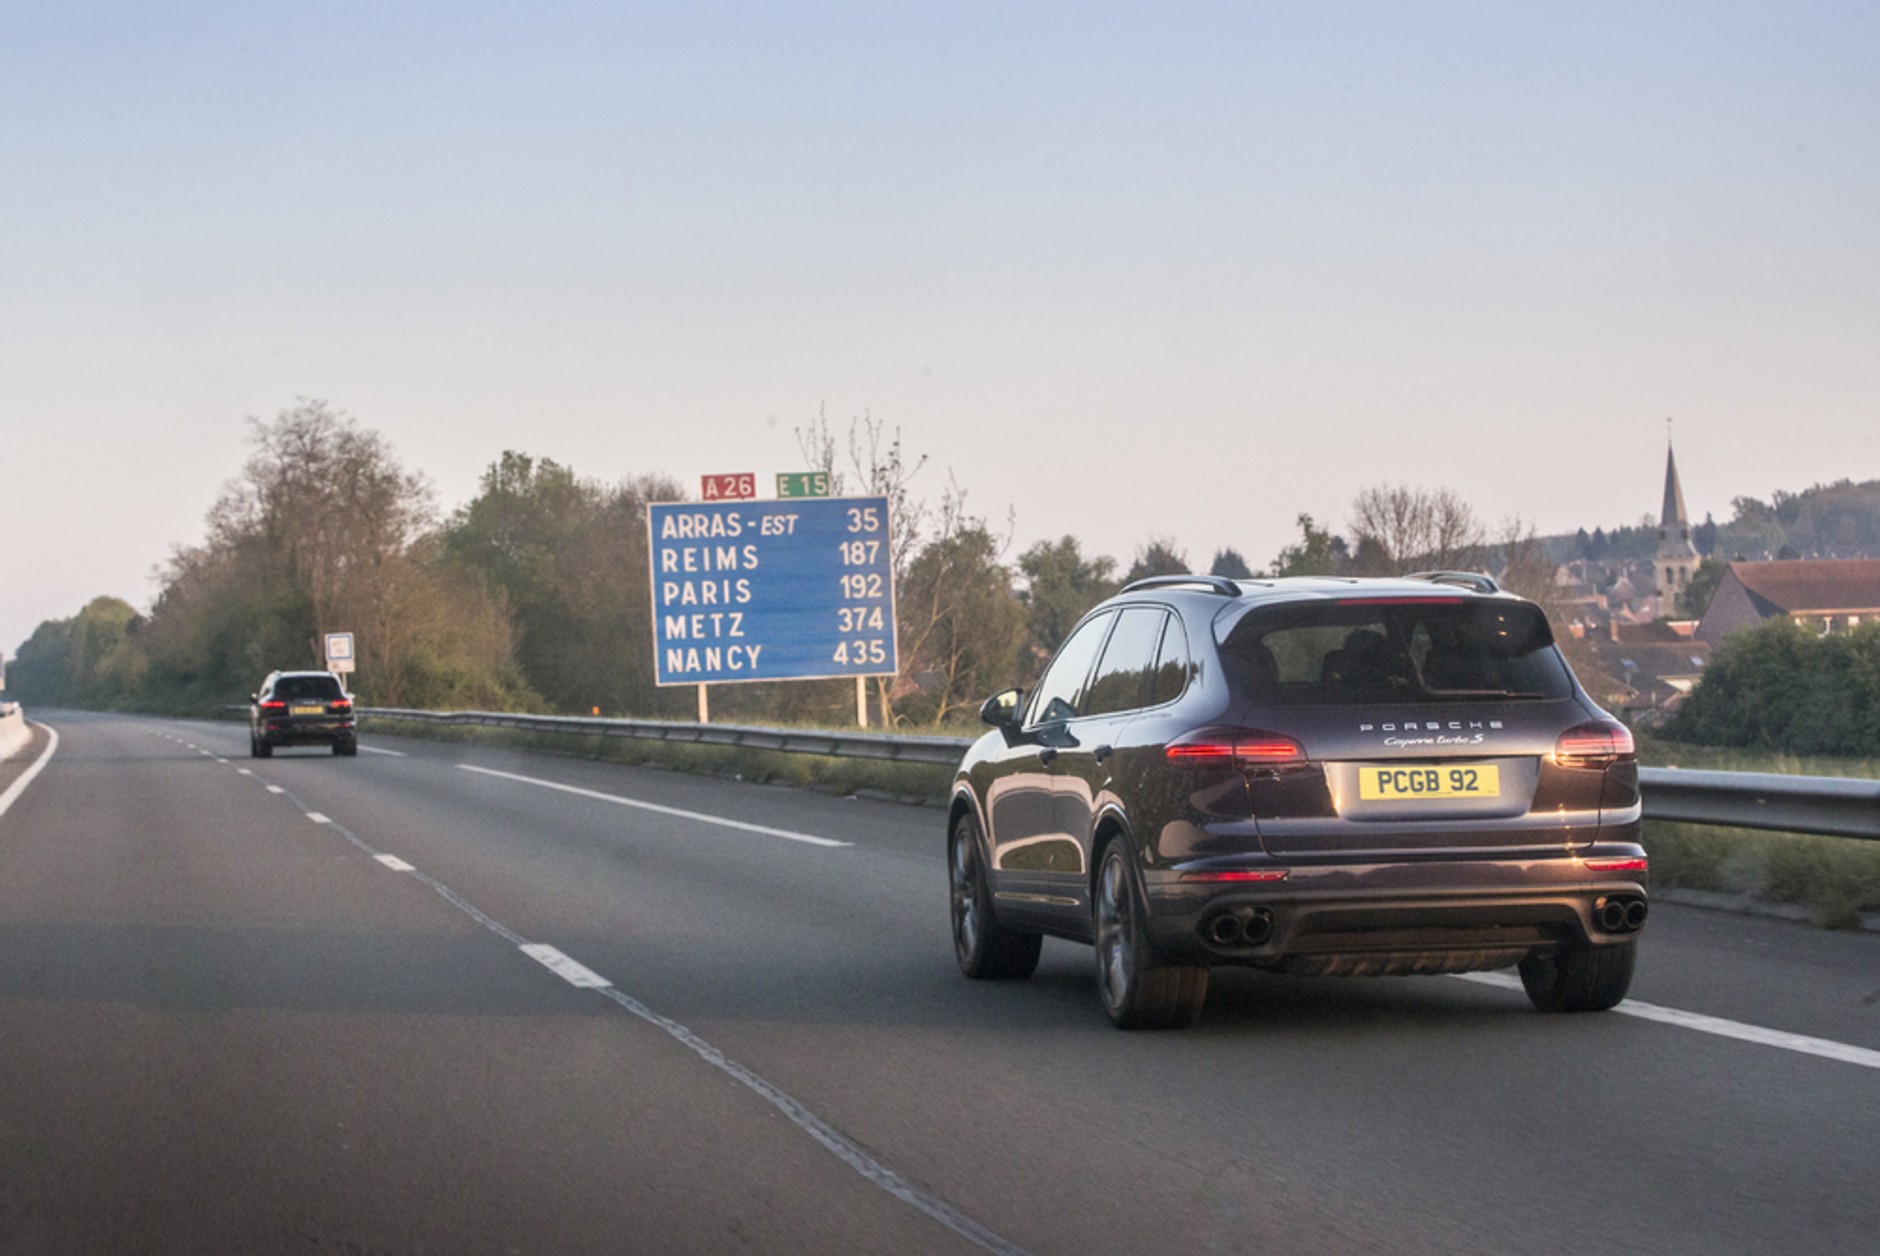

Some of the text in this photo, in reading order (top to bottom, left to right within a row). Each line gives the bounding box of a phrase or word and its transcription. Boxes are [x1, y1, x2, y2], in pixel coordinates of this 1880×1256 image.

[706, 476, 752, 497] A 26
[779, 475, 828, 496] E 15
[847, 508, 880, 532] 35
[662, 541, 880, 573] REIMS 187
[663, 573, 883, 606] PARIS 192
[665, 607, 884, 640] METZ 374
[667, 639, 886, 673] NANCY 435
[1360, 721, 1503, 732] PORSCHE
[1384, 736, 1435, 748] Cayenne
[1377, 769, 1479, 794] PCGB 92
